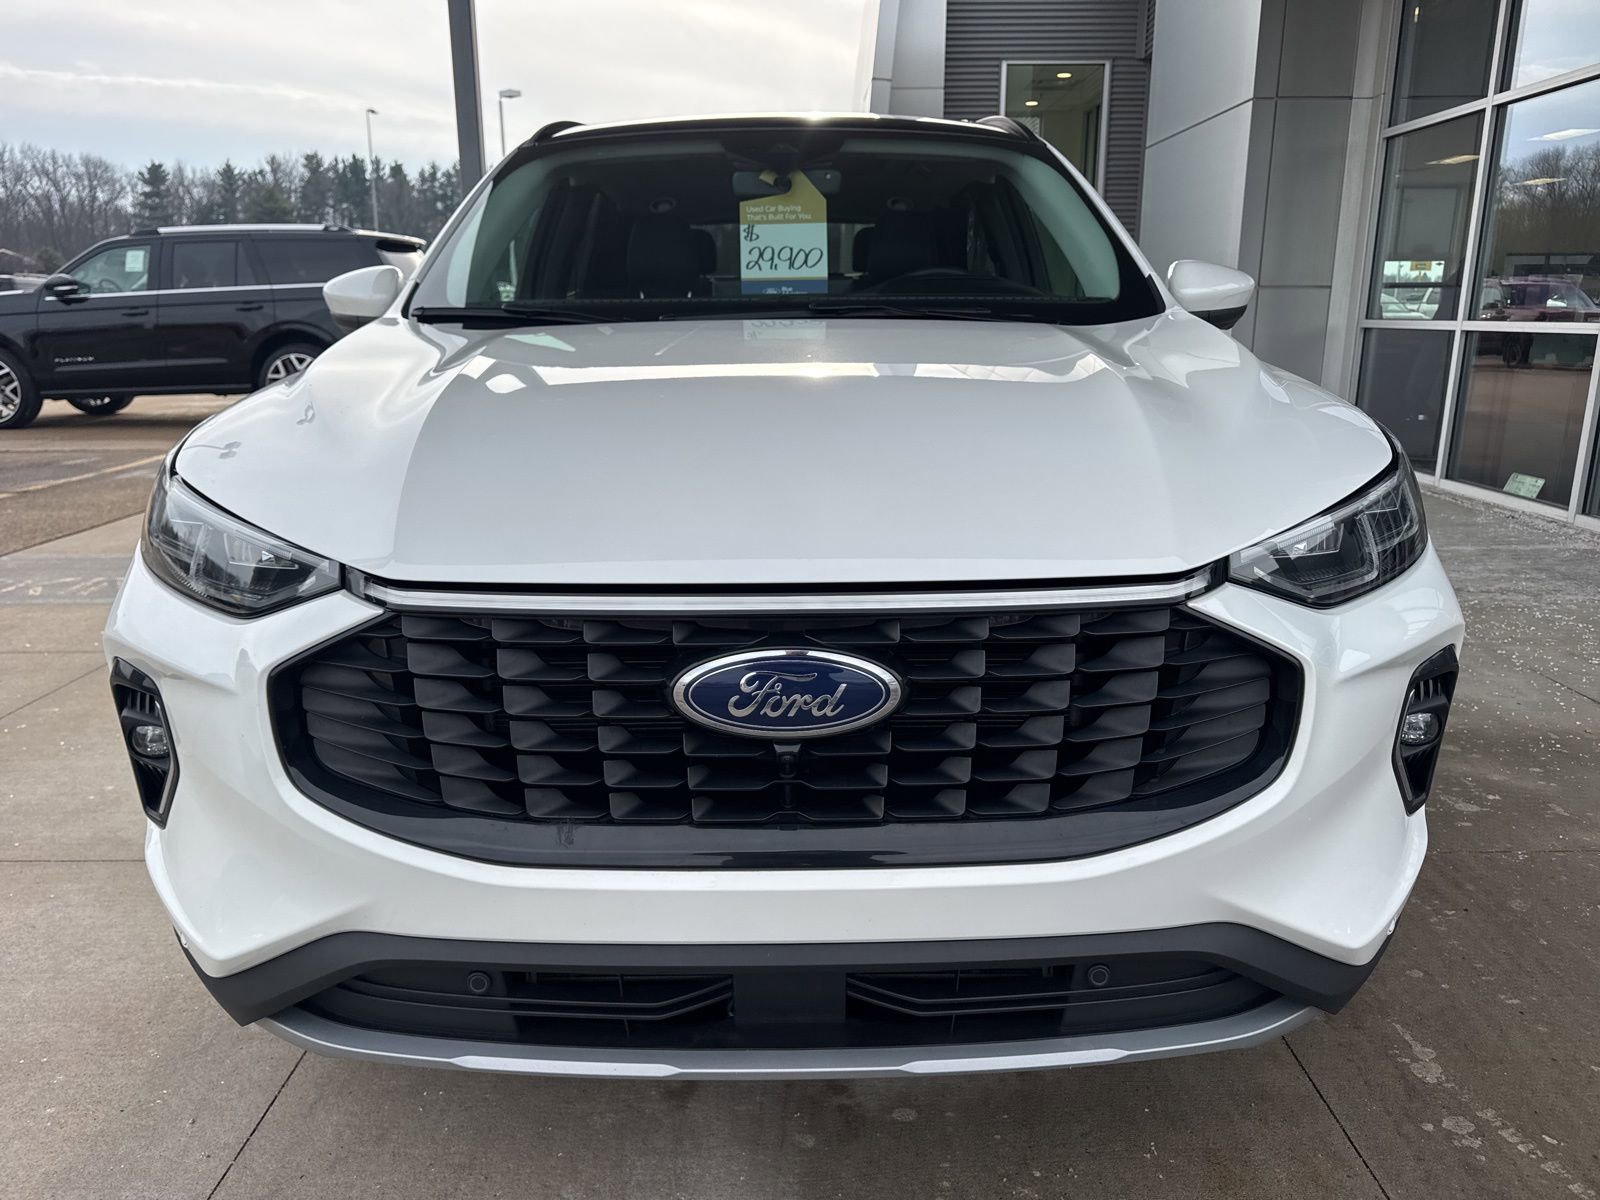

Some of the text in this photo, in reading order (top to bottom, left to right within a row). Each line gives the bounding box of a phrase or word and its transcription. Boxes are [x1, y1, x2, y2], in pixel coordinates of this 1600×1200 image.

[745, 204, 802, 214] Used Car Buying
[727, 670, 848, 718] Ford
